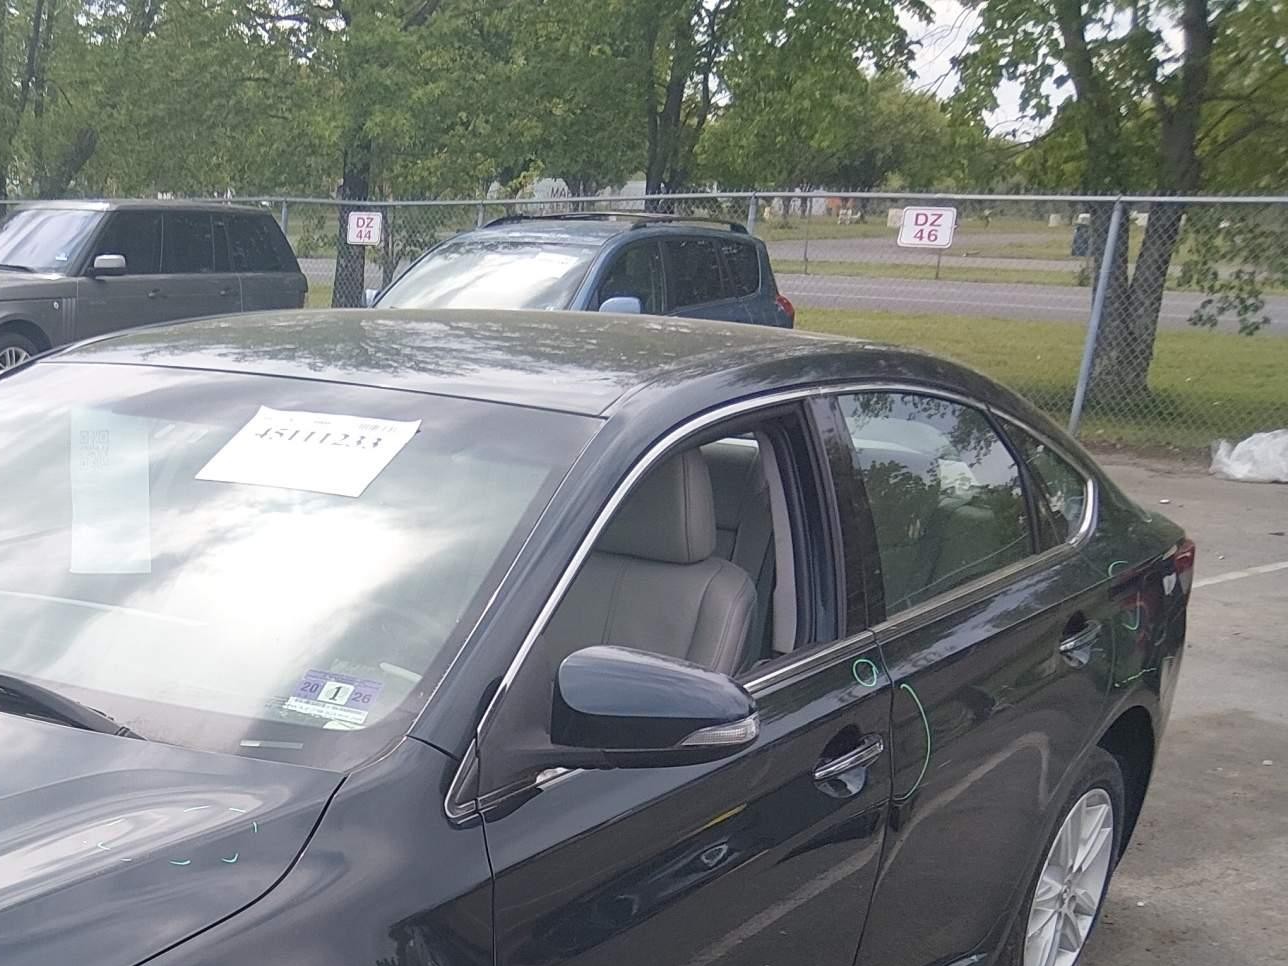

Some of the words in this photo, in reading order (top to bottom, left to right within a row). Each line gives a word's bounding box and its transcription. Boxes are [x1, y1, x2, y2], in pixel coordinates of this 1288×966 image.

[356, 217, 374, 228] DZ
[914, 212, 944, 227] DZ
[356, 229, 372, 241] 44
[913, 229, 938, 242] 46
[300, 681, 320, 694] 20
[328, 686, 343, 702] 1
[351, 691, 372, 704] 26
